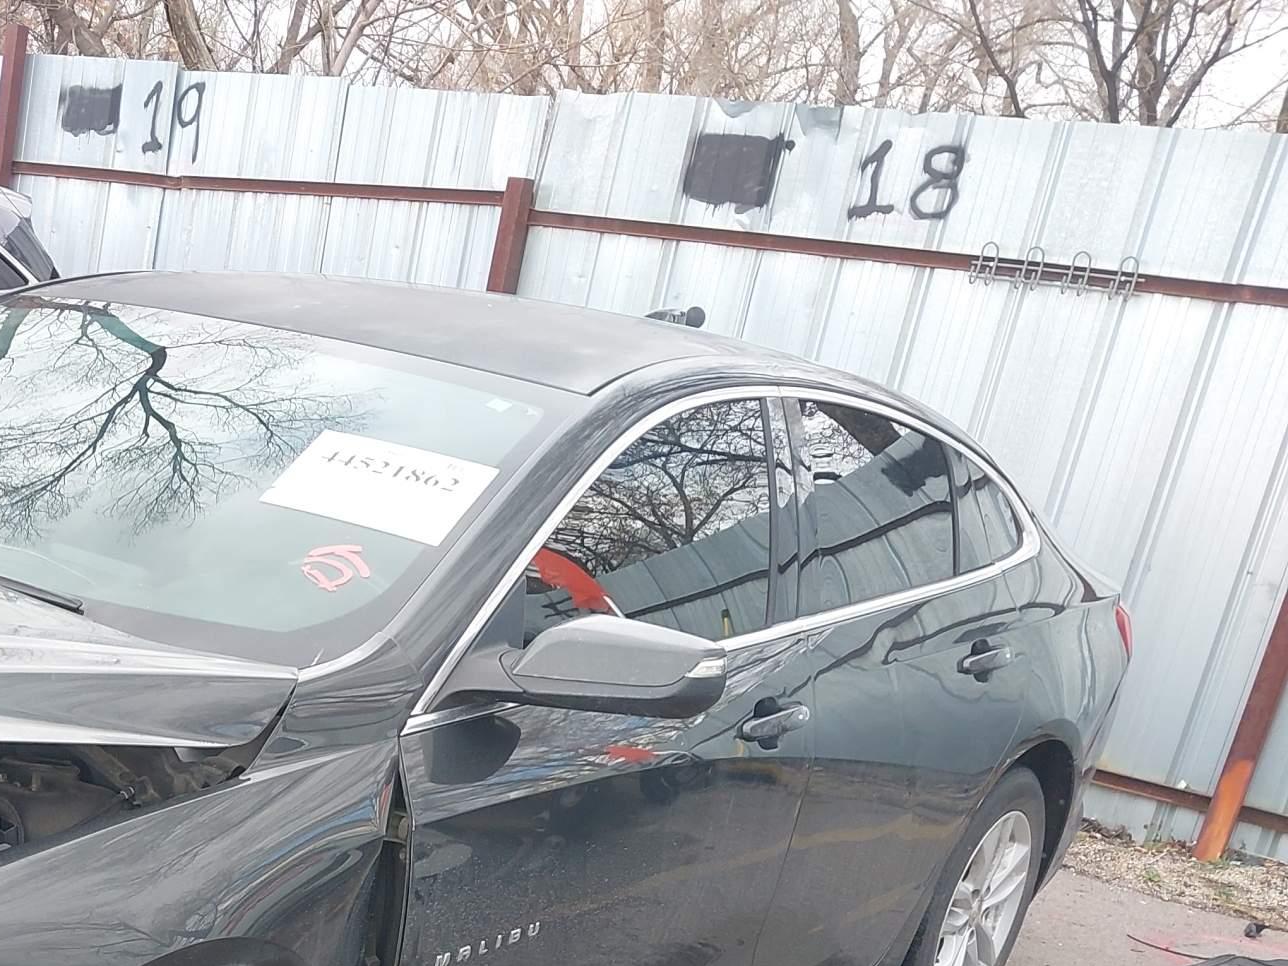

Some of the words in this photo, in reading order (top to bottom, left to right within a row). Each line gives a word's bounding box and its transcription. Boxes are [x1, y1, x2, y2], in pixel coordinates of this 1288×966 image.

[143, 79, 206, 164] 19
[847, 139, 965, 219] 18
[320, 450, 461, 493] 44521862
